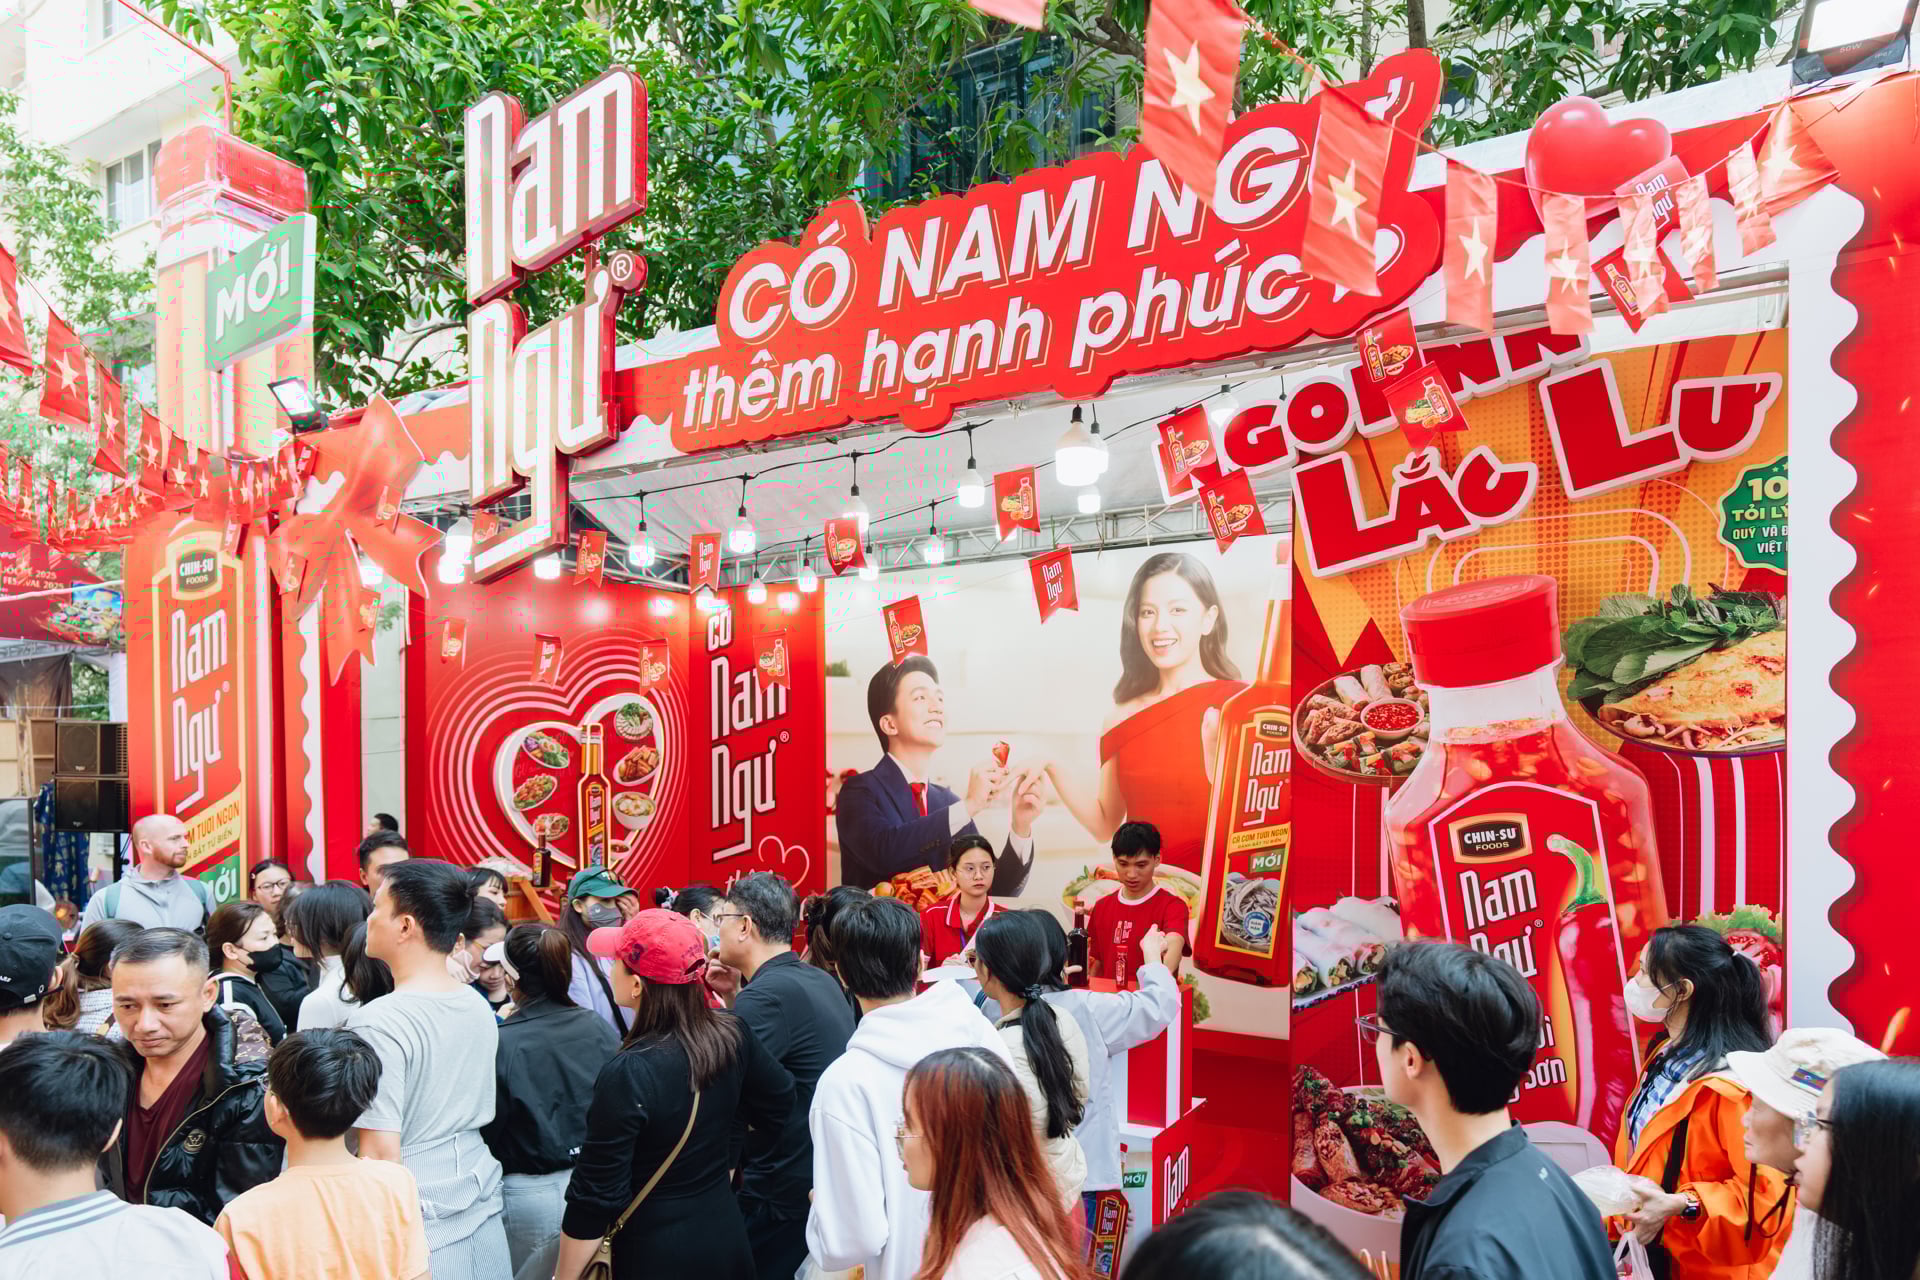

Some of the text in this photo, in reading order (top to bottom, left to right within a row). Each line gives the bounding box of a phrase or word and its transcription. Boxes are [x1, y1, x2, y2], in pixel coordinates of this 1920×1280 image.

[467, 70, 633, 301] Nam
[728, 221, 855, 341] CÓ
[878, 174, 1098, 308] NAM
[215, 238, 289, 341] MỚI
[682, 238, 1303, 428] thêm hạnh phúc
[470, 264, 613, 574] Ngư
[1296, 368, 1773, 571] LẮC LƯ
[1731, 504, 1766, 522] TỎI
[1732, 525, 1757, 540] QUÝ
[1757, 539, 1783, 555] VIỆT
[179, 558, 214, 577] CHIN-SU
[185, 574, 208, 585] FOODS
[1042, 561, 1062, 582] Nam
[1046, 577, 1063, 606] Ngư
[171, 608, 228, 694] Nam
[1262, 723, 1288, 733] CHIN-SU
[173, 689, 222, 815] Ngư
[1249, 742, 1291, 777] Nam
[216, 800, 240, 828] NGON
[711, 738, 777, 862] Ngư
[1242, 778, 1284, 827] Ngư
[1271, 827, 1288, 838] NGON
[1464, 827, 1517, 844] CHIN-SU
[1475, 841, 1510, 851] FOODS
[1252, 852, 1282, 870] MỚI
[208, 866, 237, 903] ỚI
[1460, 868, 1538, 931] Nam
[1123, 1171, 1146, 1185] MỚI
[1163, 1144, 1189, 1225] Nam
